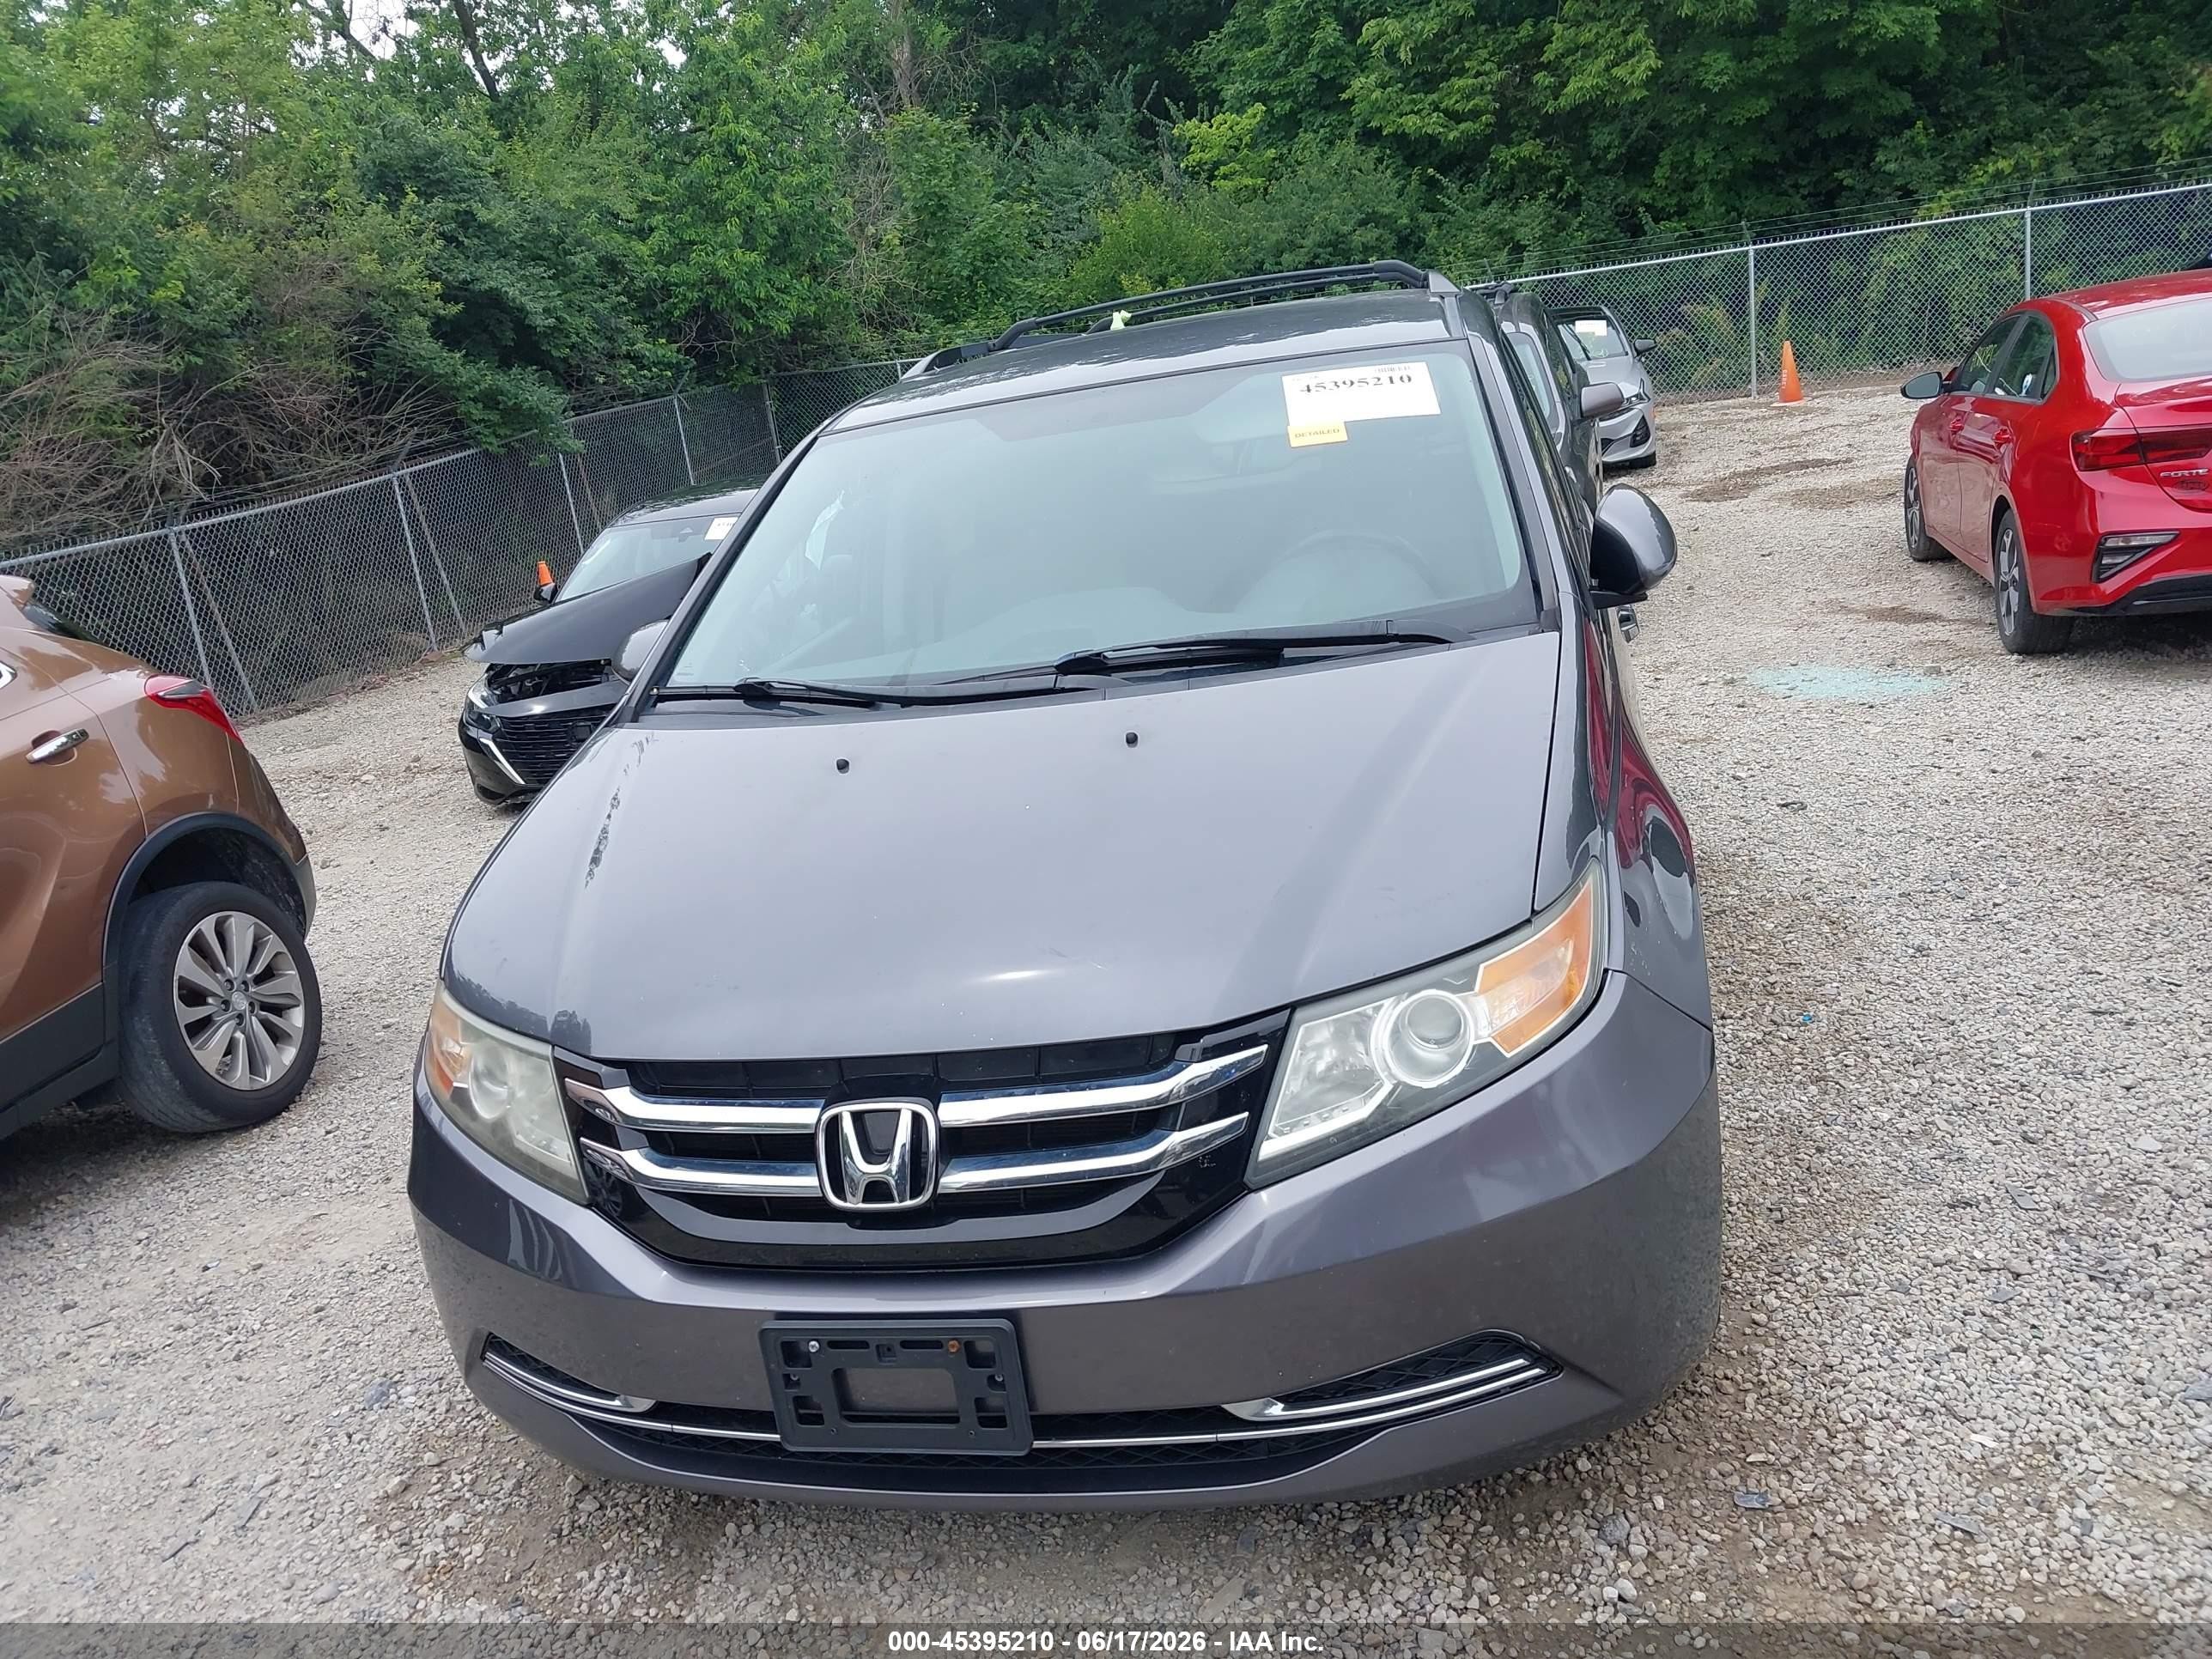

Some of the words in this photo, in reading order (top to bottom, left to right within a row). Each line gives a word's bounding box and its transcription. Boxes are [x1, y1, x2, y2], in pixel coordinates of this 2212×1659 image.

[1300, 374, 1413, 393] 45395210
[1294, 428, 1340, 439] DETAILED
[2160, 468, 2209, 477] FORTE
